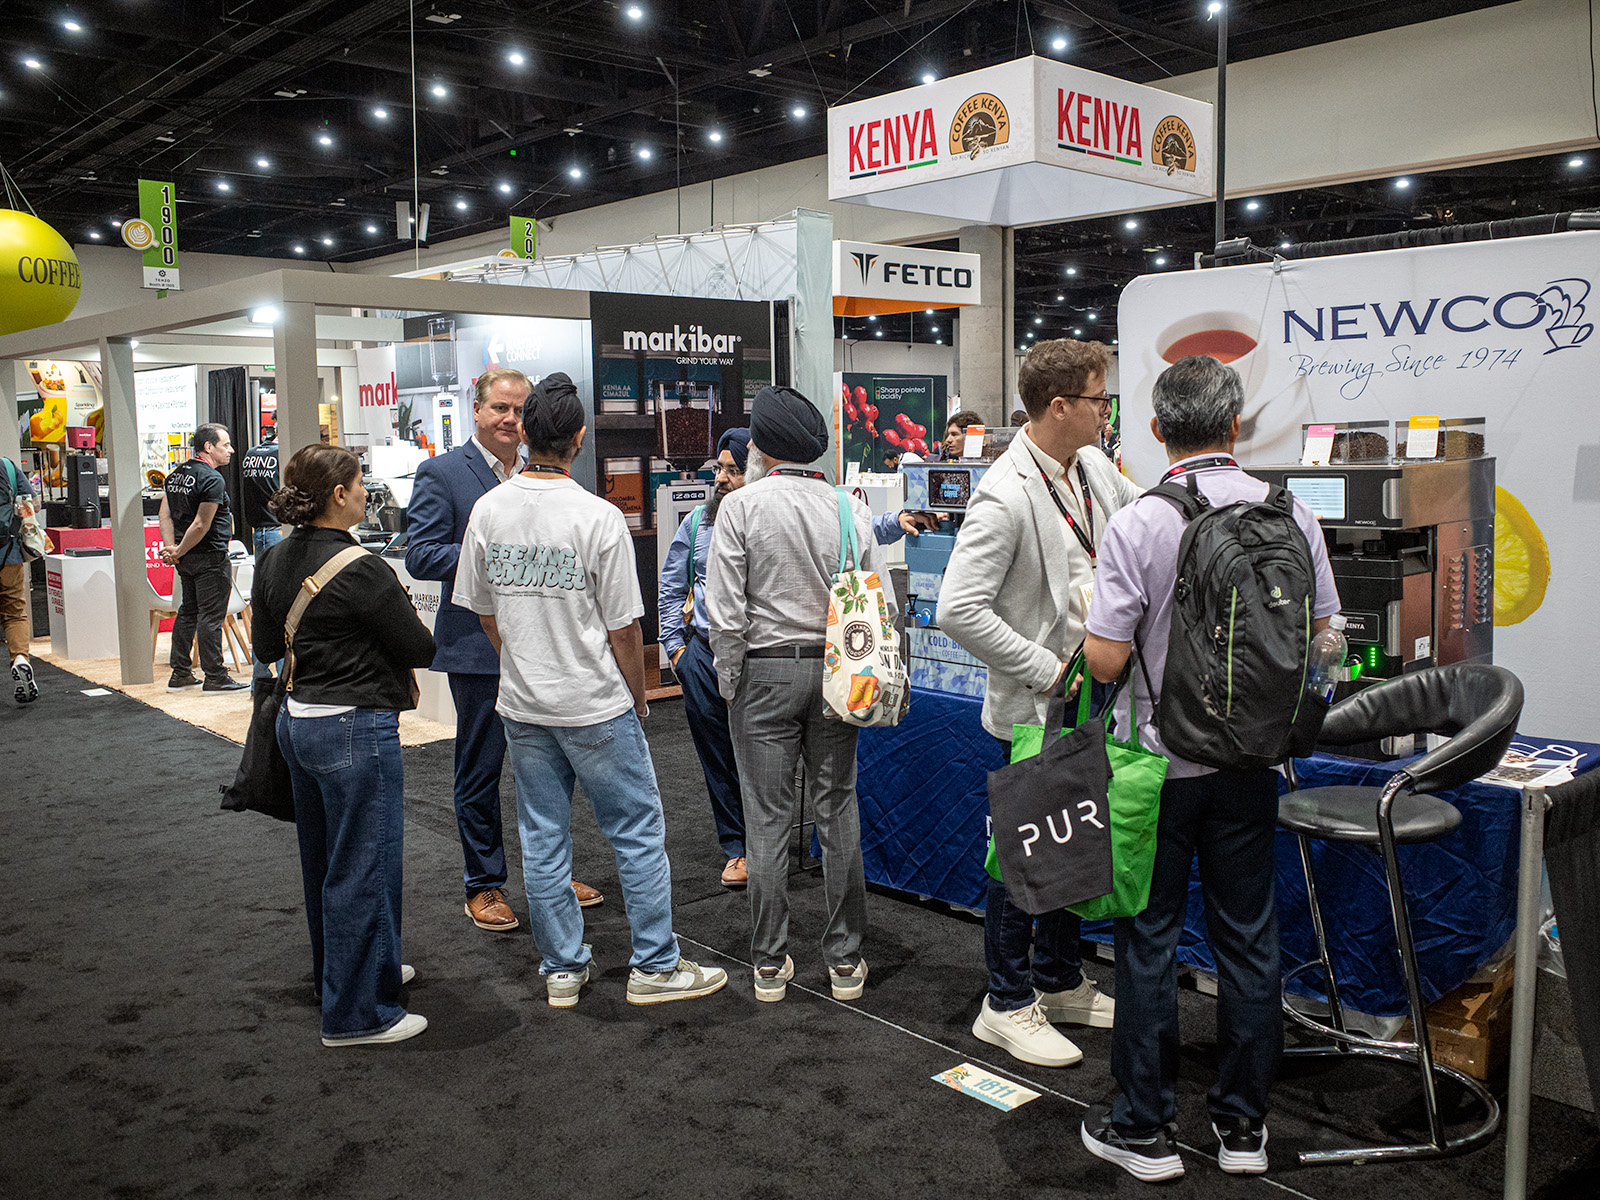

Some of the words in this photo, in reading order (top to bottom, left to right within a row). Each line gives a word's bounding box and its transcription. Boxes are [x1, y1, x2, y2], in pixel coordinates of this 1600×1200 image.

[952, 99, 979, 142] COFFEE
[981, 97, 1007, 131] KENYA
[1058, 88, 1142, 159] KENYA
[849, 108, 938, 173] KENYA
[1154, 120, 1175, 153] COFFEE
[1177, 122, 1194, 159] KENYA
[161, 185, 175, 265] 1900
[524, 221, 534, 259] 20
[18, 256, 80, 289] COFFEE
[884, 262, 972, 288] FETCO
[1283, 291, 1547, 344] NEWCO
[623, 324, 737, 354] markibar
[676, 357, 698, 365] GRIND
[699, 357, 718, 366] YOUR
[719, 358, 735, 366] WAY
[1289, 354, 1384, 400] Brewing
[1385, 344, 1447, 378] Since
[1456, 347, 1522, 371] 1974
[242, 456, 278, 469] GRIND
[258, 469, 276, 478] WAY
[168, 473, 196, 487] GRIND
[486, 543, 577, 568] FEELING
[414, 593, 439, 604] MARKIBAR
[414, 601, 439, 612] CONNECT
[1268, 599, 1290, 609] deuter
[1346, 622, 1365, 630] KENYA
[928, 636, 948, 648] COLD
[941, 650, 958, 658] COFFEE
[973, 1078, 1017, 1098] 1811
